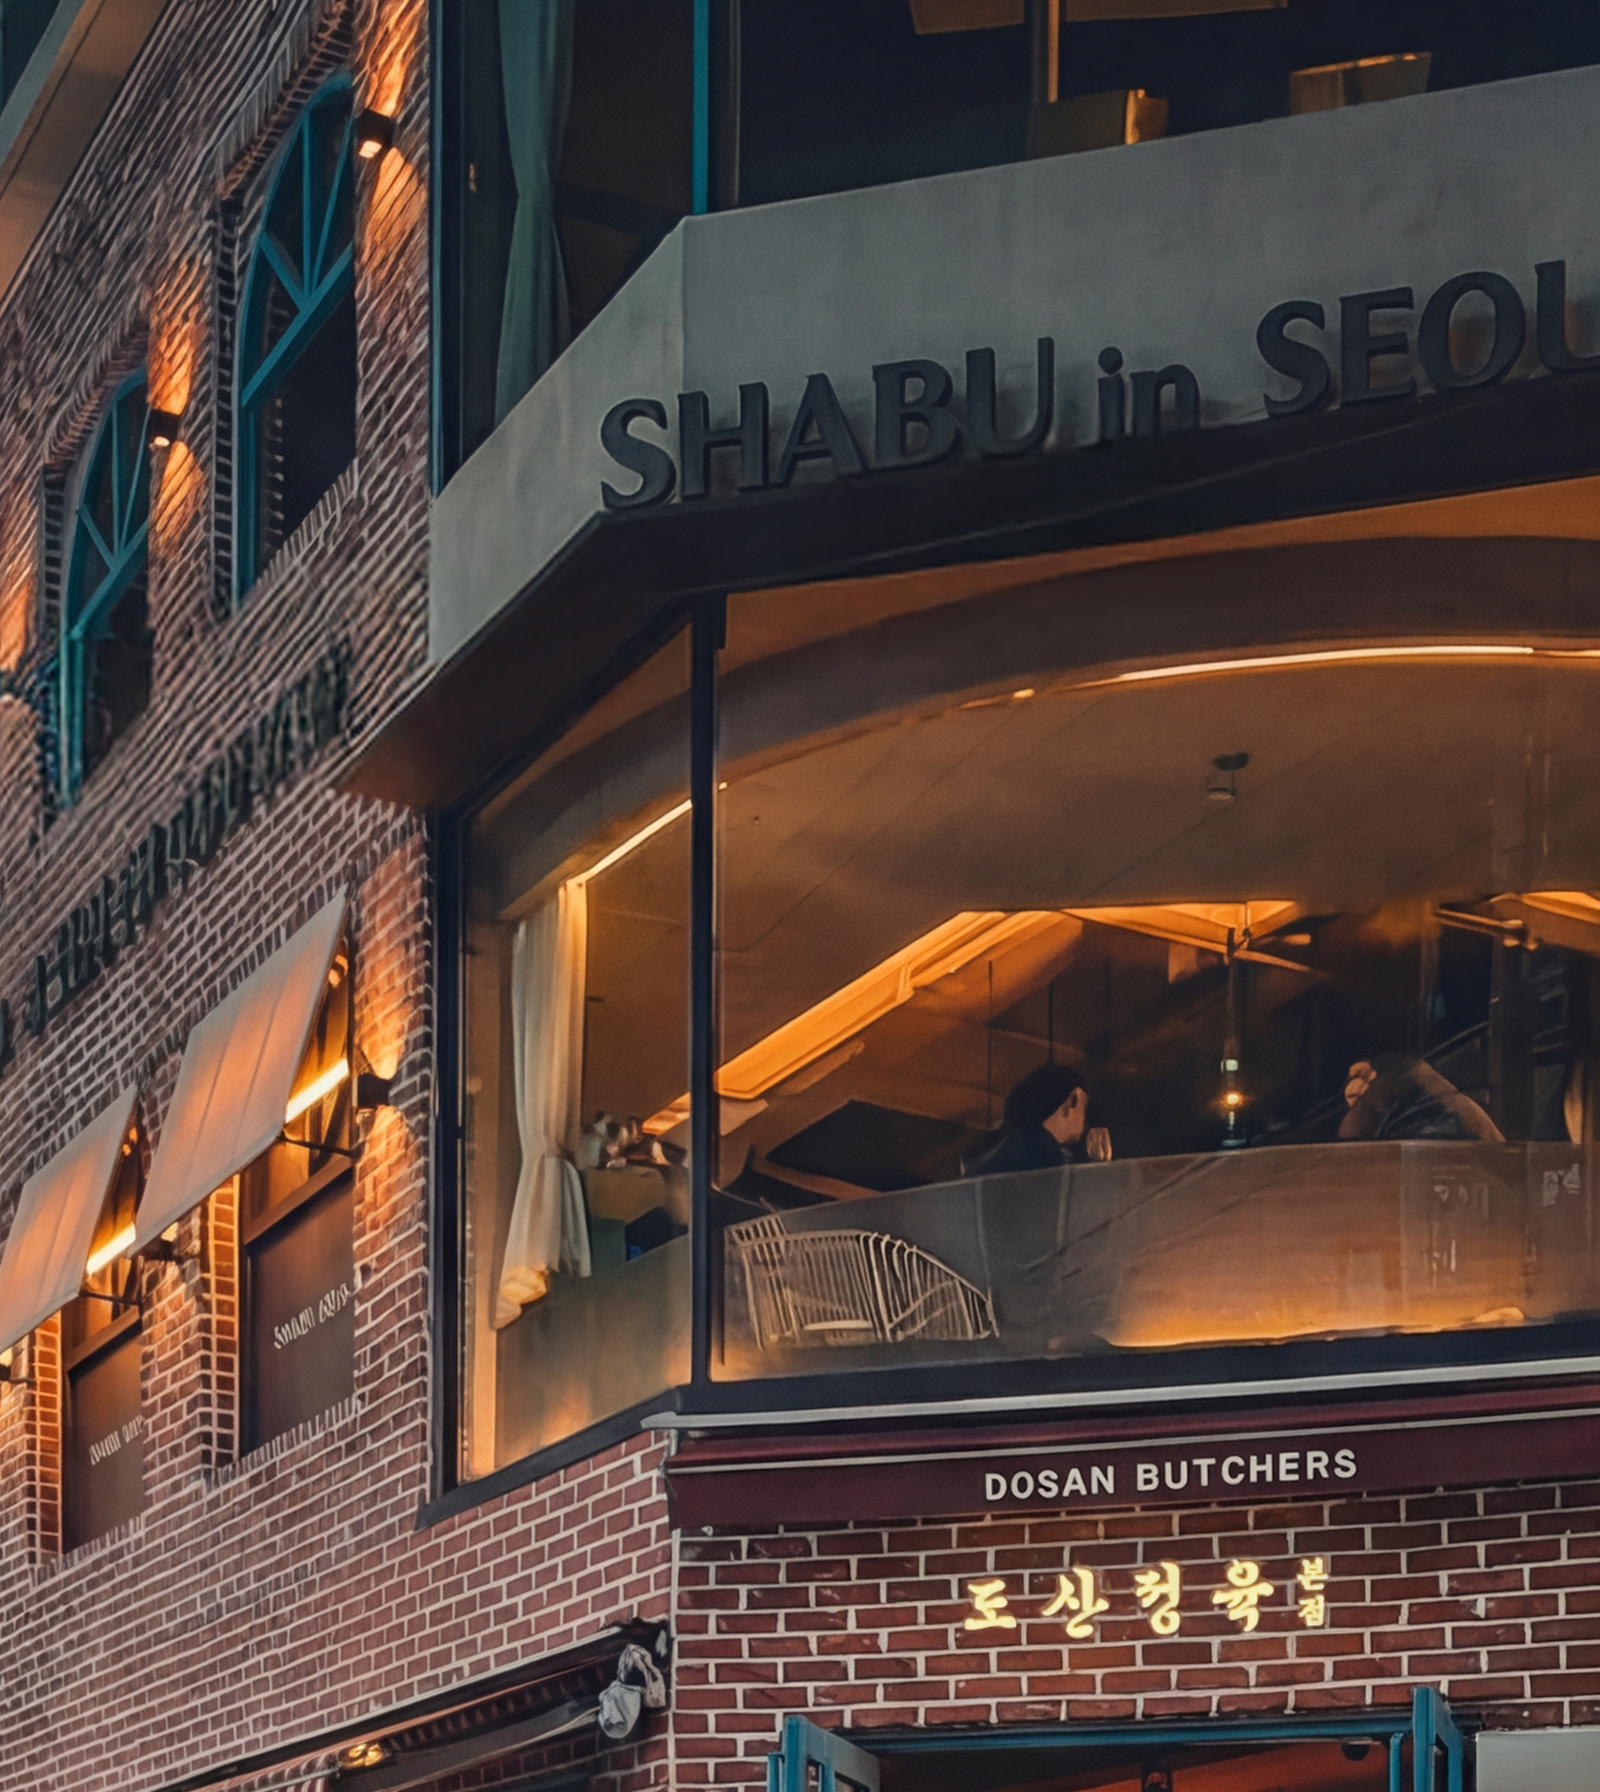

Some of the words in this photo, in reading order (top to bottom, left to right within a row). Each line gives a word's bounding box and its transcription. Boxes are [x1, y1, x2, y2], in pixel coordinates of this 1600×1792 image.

[600, 335, 1056, 510] SHABU
[1097, 346, 1200, 446] in
[984, 1465, 1115, 1501] DOSAN
[1136, 1448, 1358, 1492] BUTCHERS
[963, 1558, 1275, 1640] 도산정육
